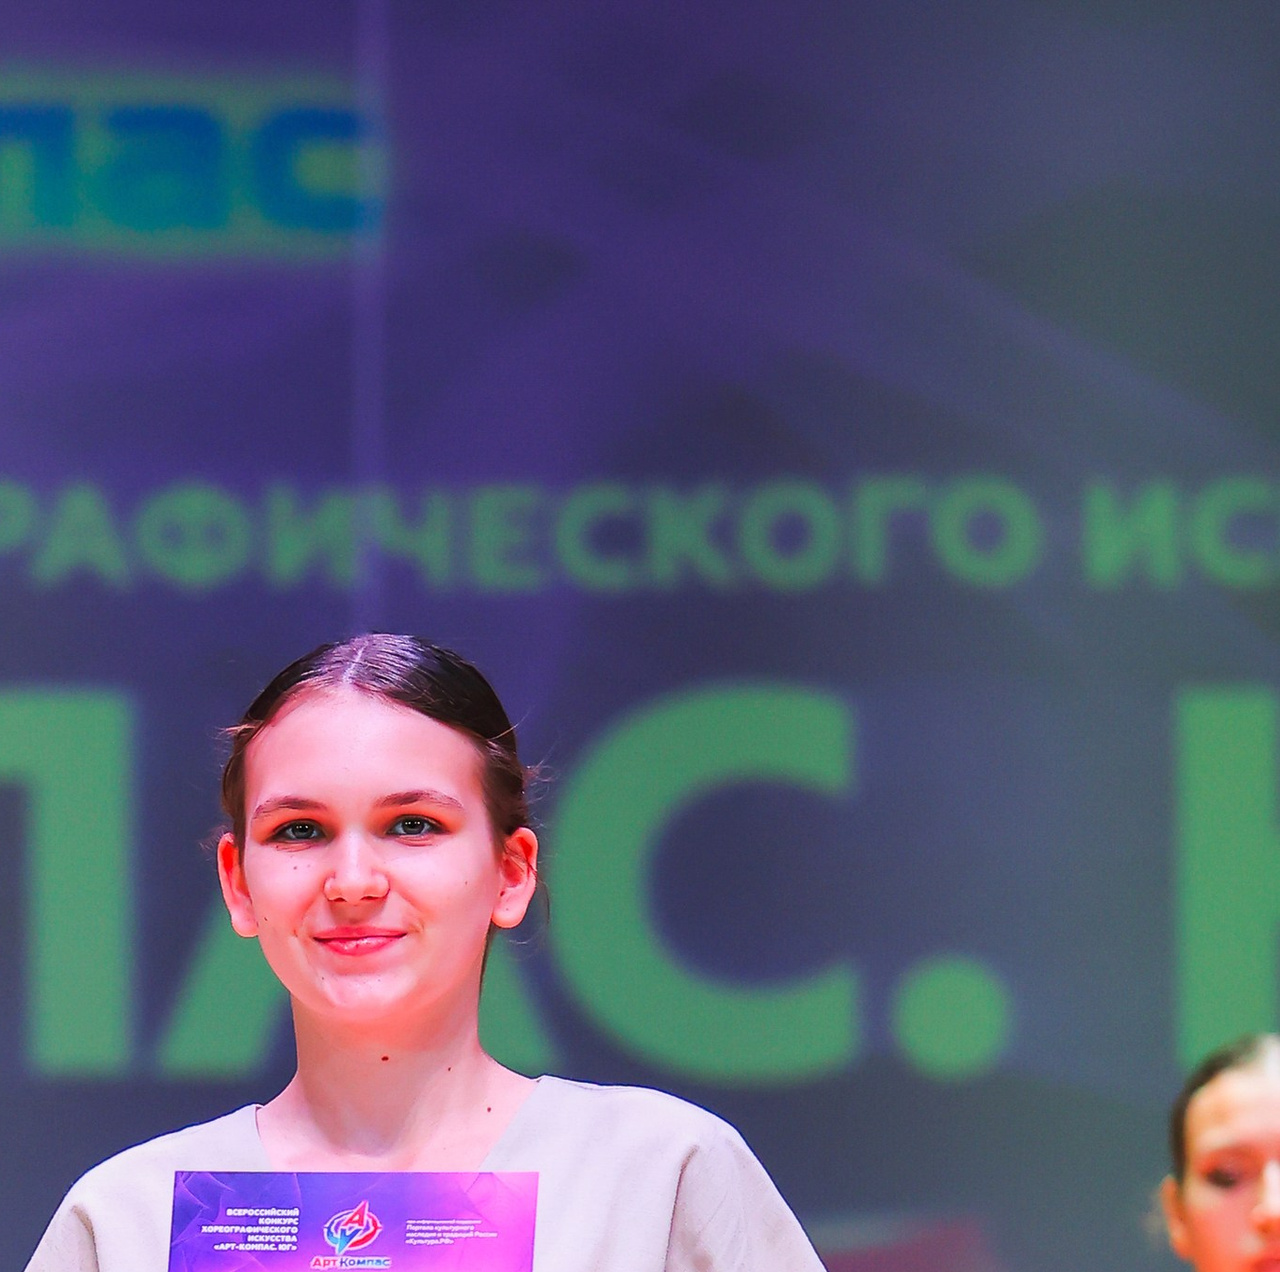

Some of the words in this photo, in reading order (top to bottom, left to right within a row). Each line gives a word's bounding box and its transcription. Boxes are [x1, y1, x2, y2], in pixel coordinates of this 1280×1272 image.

[226, 1207, 300, 1217] ВСЕРОССИЙСКИЙ
[258, 1217, 299, 1226] КОНКУРС
[201, 1225, 299, 1234] ХОРЕОГРАФИЧЕСКОГО
[247, 1234, 298, 1242] ИСКУССТВА
[278, 1243, 297, 1251] ЮГ»
